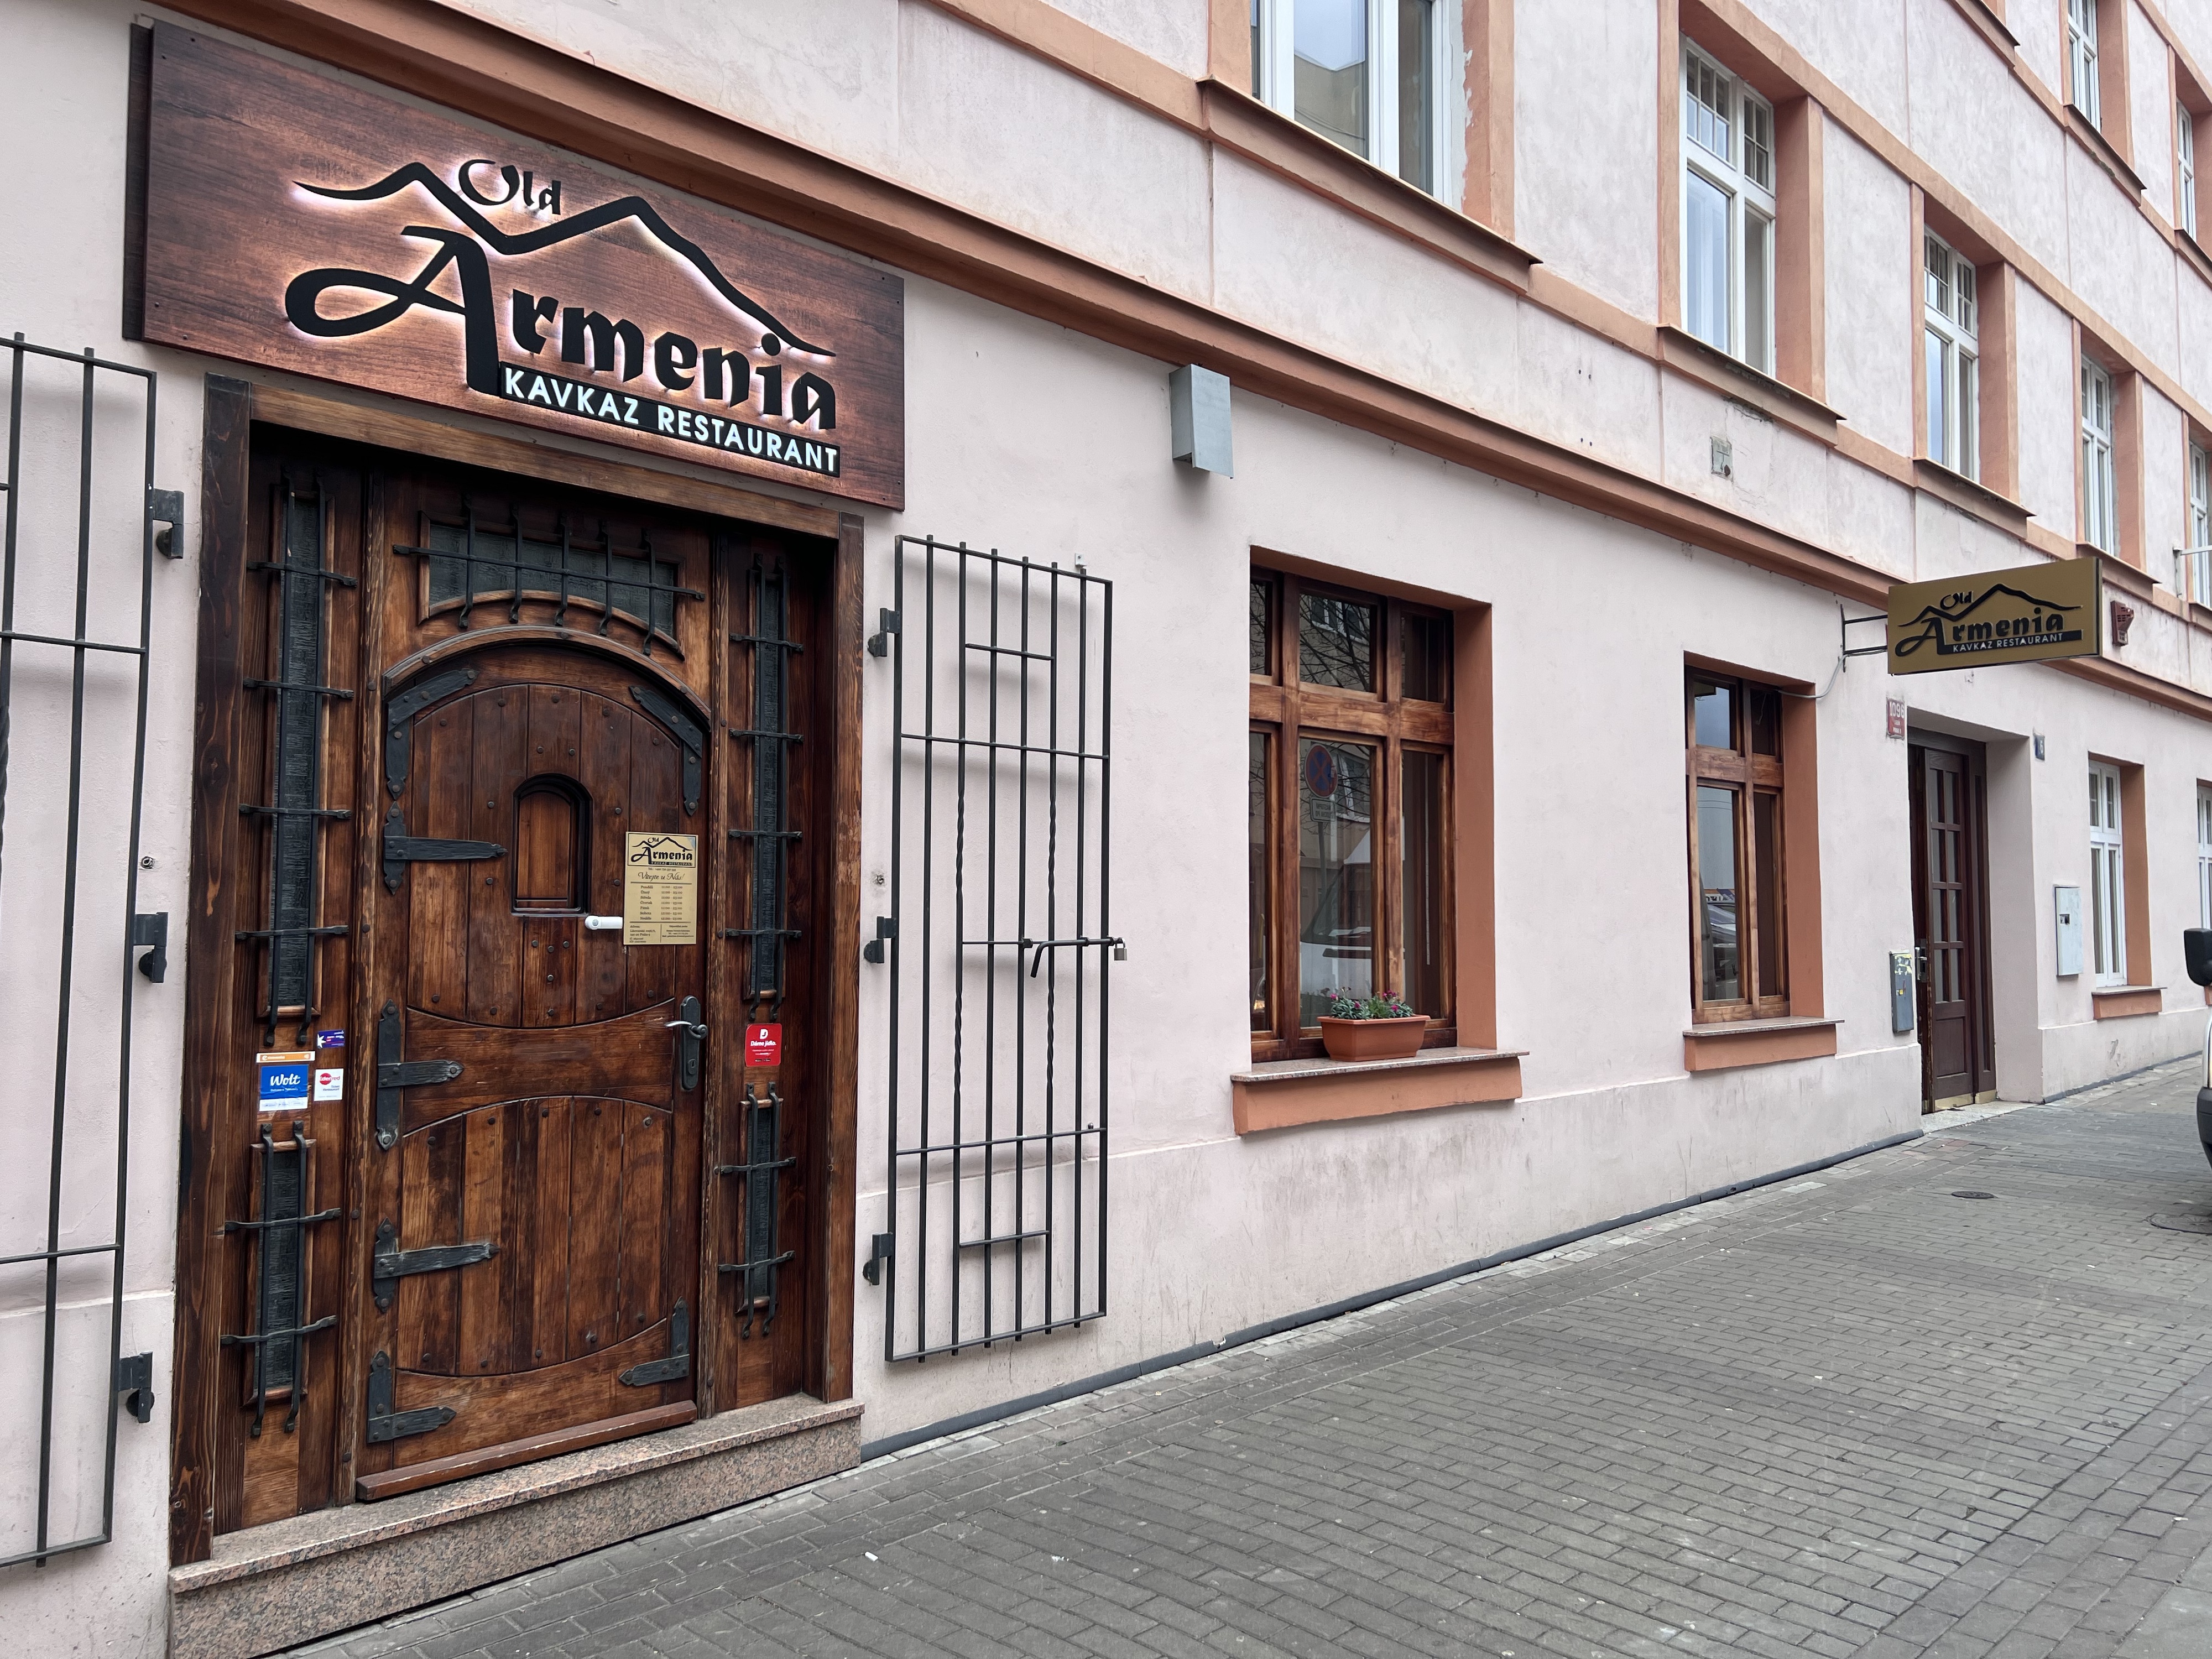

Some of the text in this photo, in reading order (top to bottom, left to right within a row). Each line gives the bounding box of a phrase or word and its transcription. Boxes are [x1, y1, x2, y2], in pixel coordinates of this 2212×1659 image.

[459, 158, 562, 216] Old
[284, 225, 836, 430] Armenia
[504, 367, 838, 474] KAVKAZ RESTAURANT
[1940, 591, 1974, 609] Old
[1895, 607, 2064, 657] Armenia
[1953, 633, 2063, 653] KAVKAZ RESTAURANT
[1890, 701, 1905, 718] 1096
[631, 847, 693, 865] Armenia
[270, 1073, 301, 1086] Wolt
